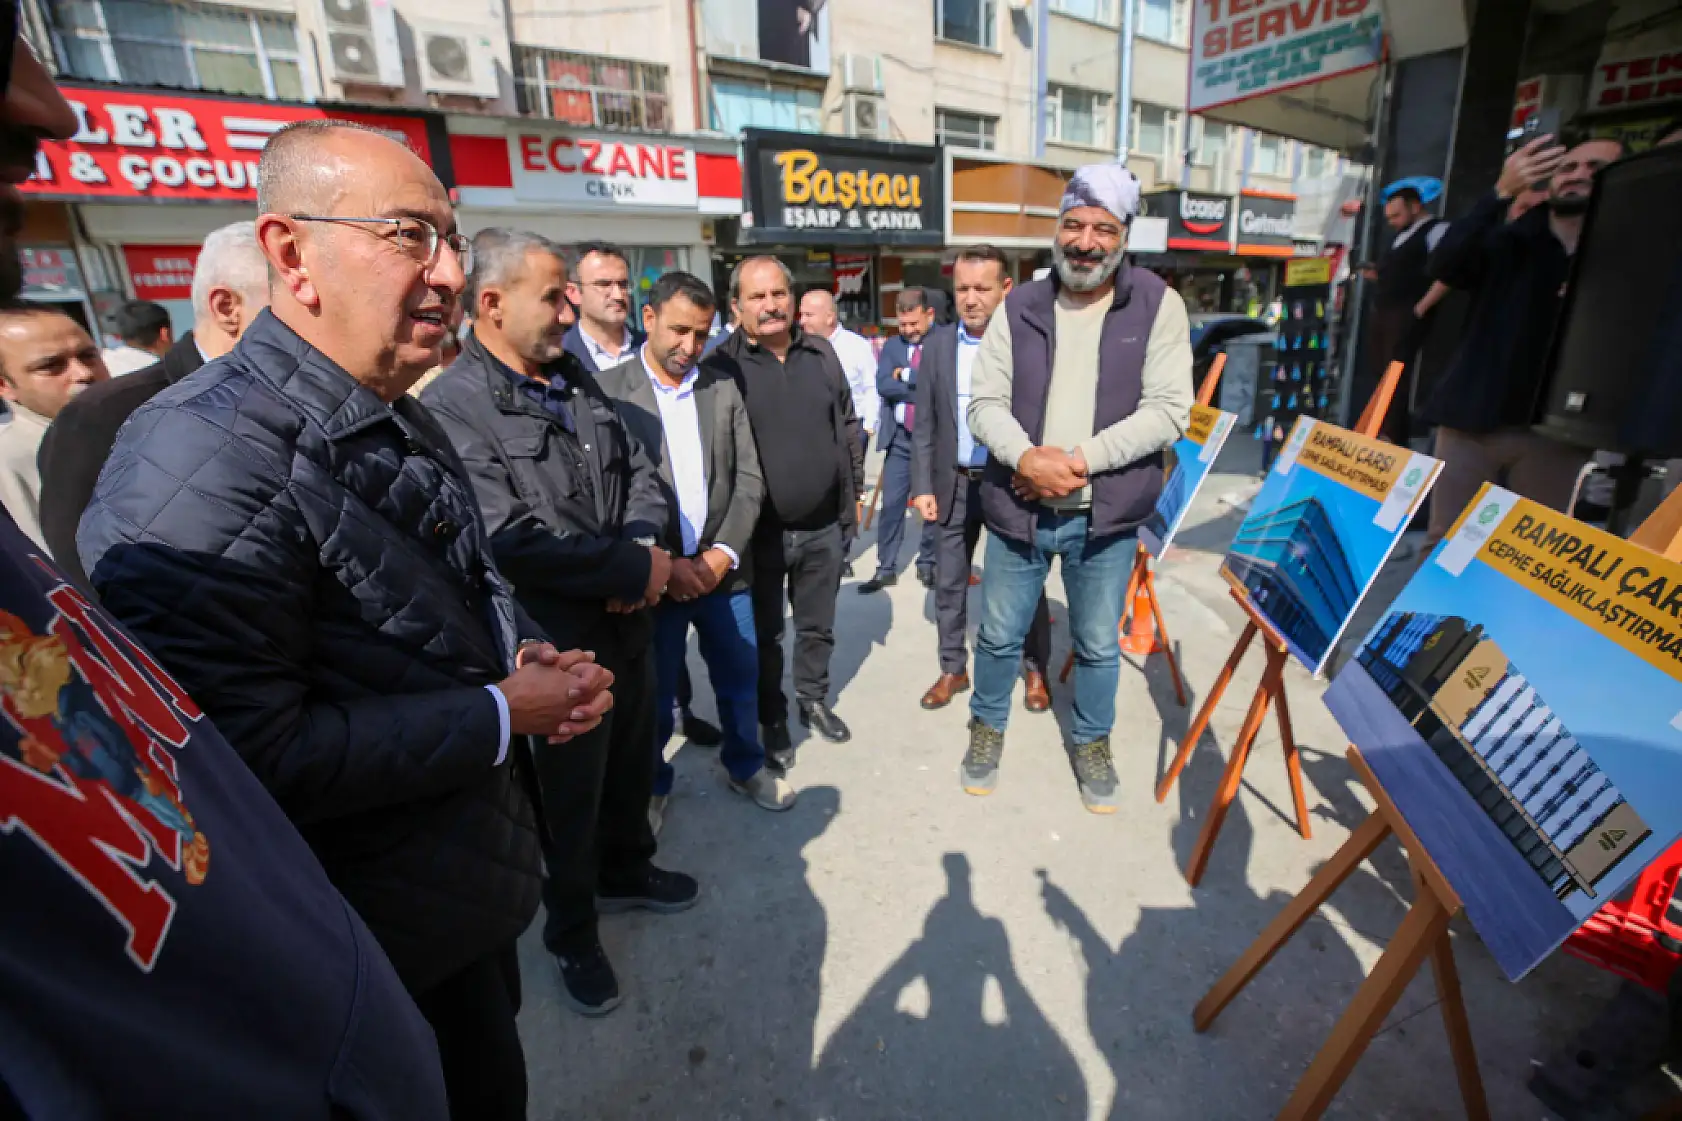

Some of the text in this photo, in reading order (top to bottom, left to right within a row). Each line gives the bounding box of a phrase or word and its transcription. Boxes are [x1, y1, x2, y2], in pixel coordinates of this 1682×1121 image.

[519, 134, 688, 181] ECZANE
[585, 180, 636, 198] CENK
[784, 206, 840, 229] EŞARP
[868, 210, 923, 231] ÇANTA
[1511, 514, 1682, 629] RAMPALI ÇAR
[1488, 538, 1682, 664] CEPHE SAĞLIKLAŞTIRMA
